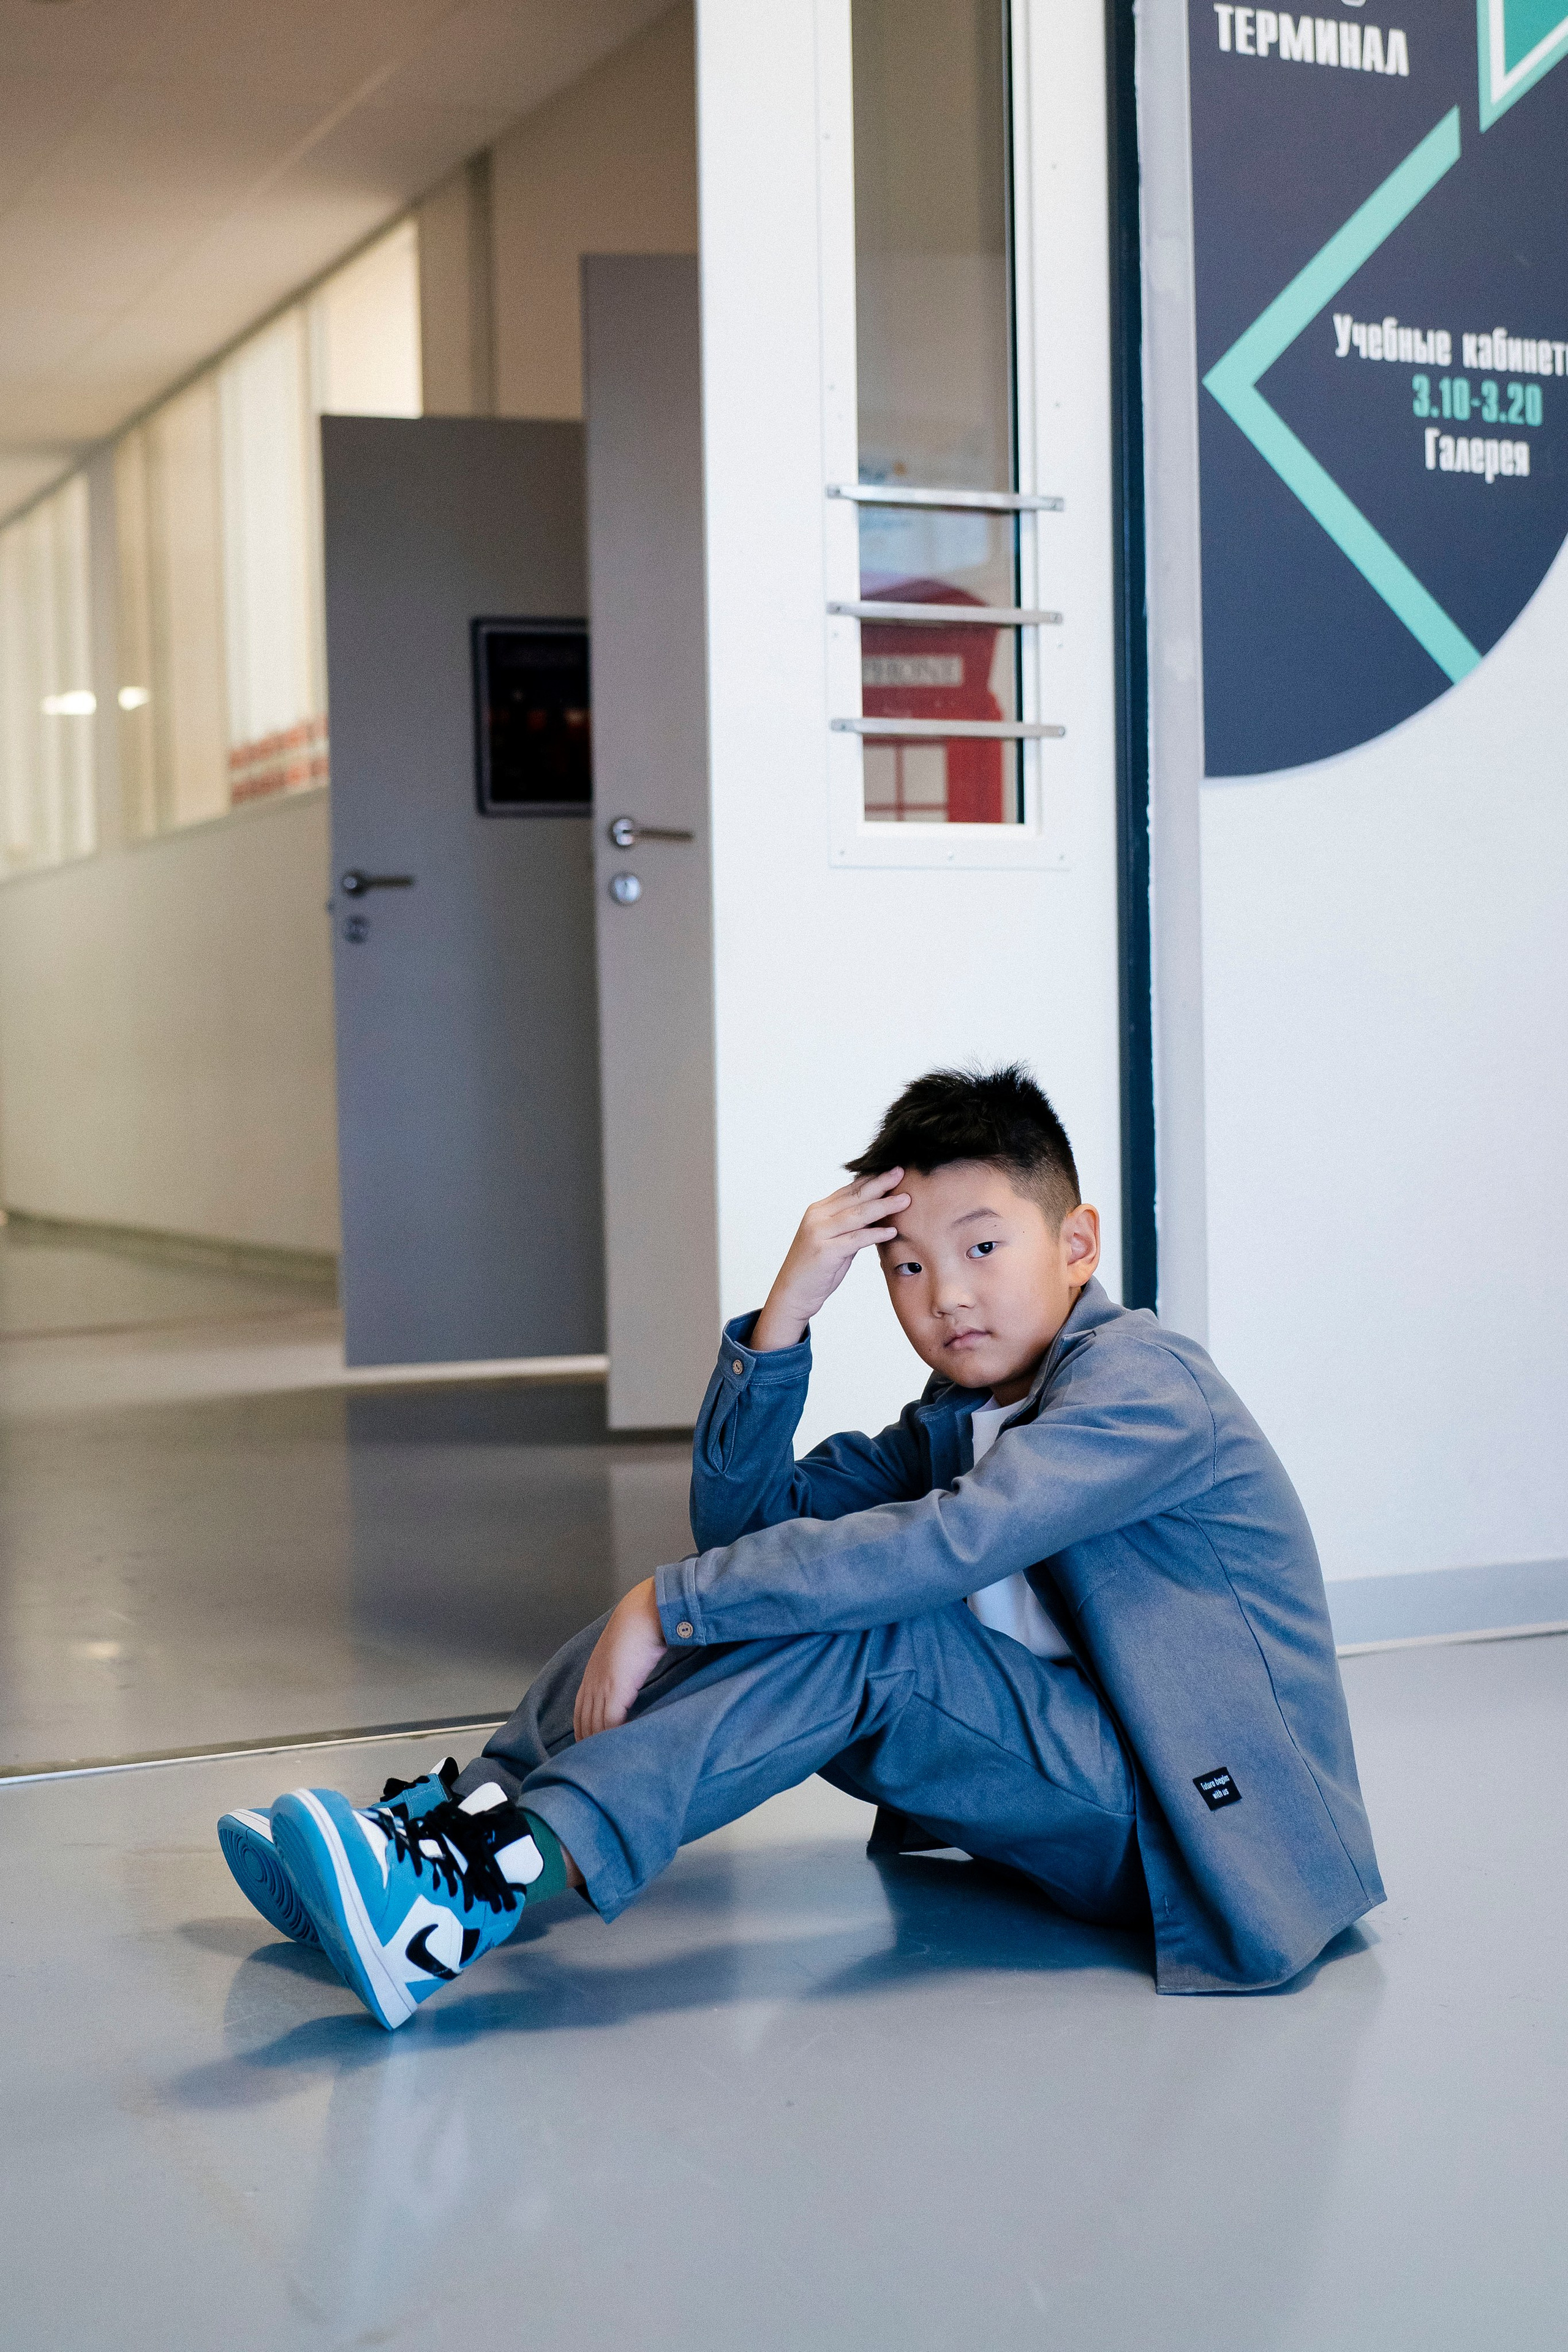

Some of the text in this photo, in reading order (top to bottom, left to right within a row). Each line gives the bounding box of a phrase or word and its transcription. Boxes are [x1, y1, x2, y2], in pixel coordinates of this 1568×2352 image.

[1213, 2, 1408, 77] ТЕРМИНАЛ
[1333, 313, 1568, 376] Учебные кабинет
[1412, 373, 1542, 427] 3.10-3.20
[1425, 427, 1530, 484] Галерея
[1213, 1789, 1223, 1800] with
